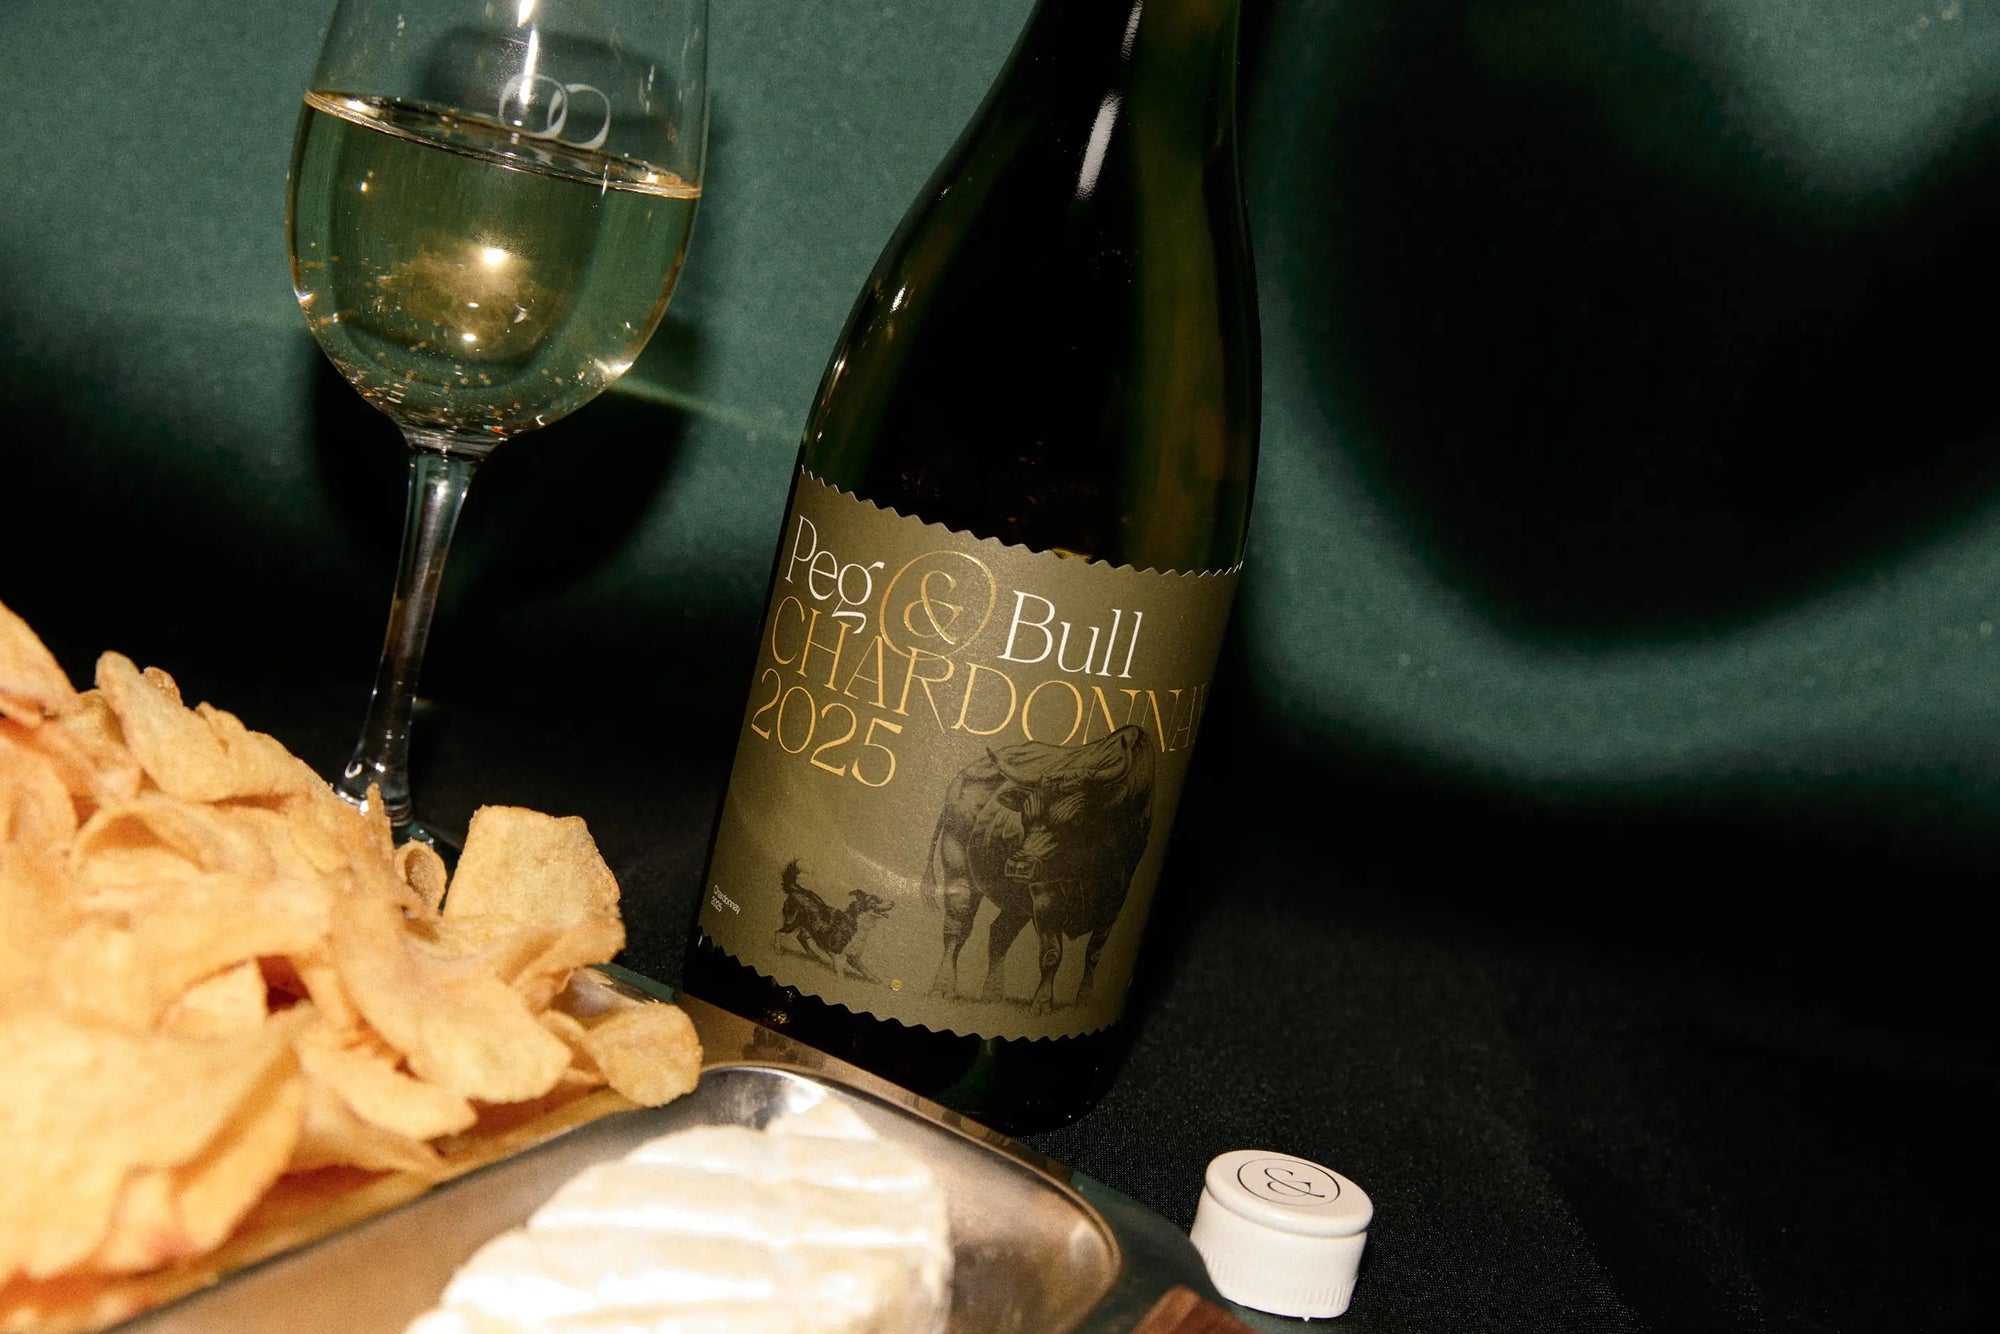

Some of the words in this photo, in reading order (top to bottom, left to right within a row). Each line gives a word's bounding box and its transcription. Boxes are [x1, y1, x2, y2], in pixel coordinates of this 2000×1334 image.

[784, 515, 885, 634] Peg
[998, 590, 1144, 679] Bull
[750, 667, 904, 787] 2025
[1263, 1167, 1326, 1198] &
